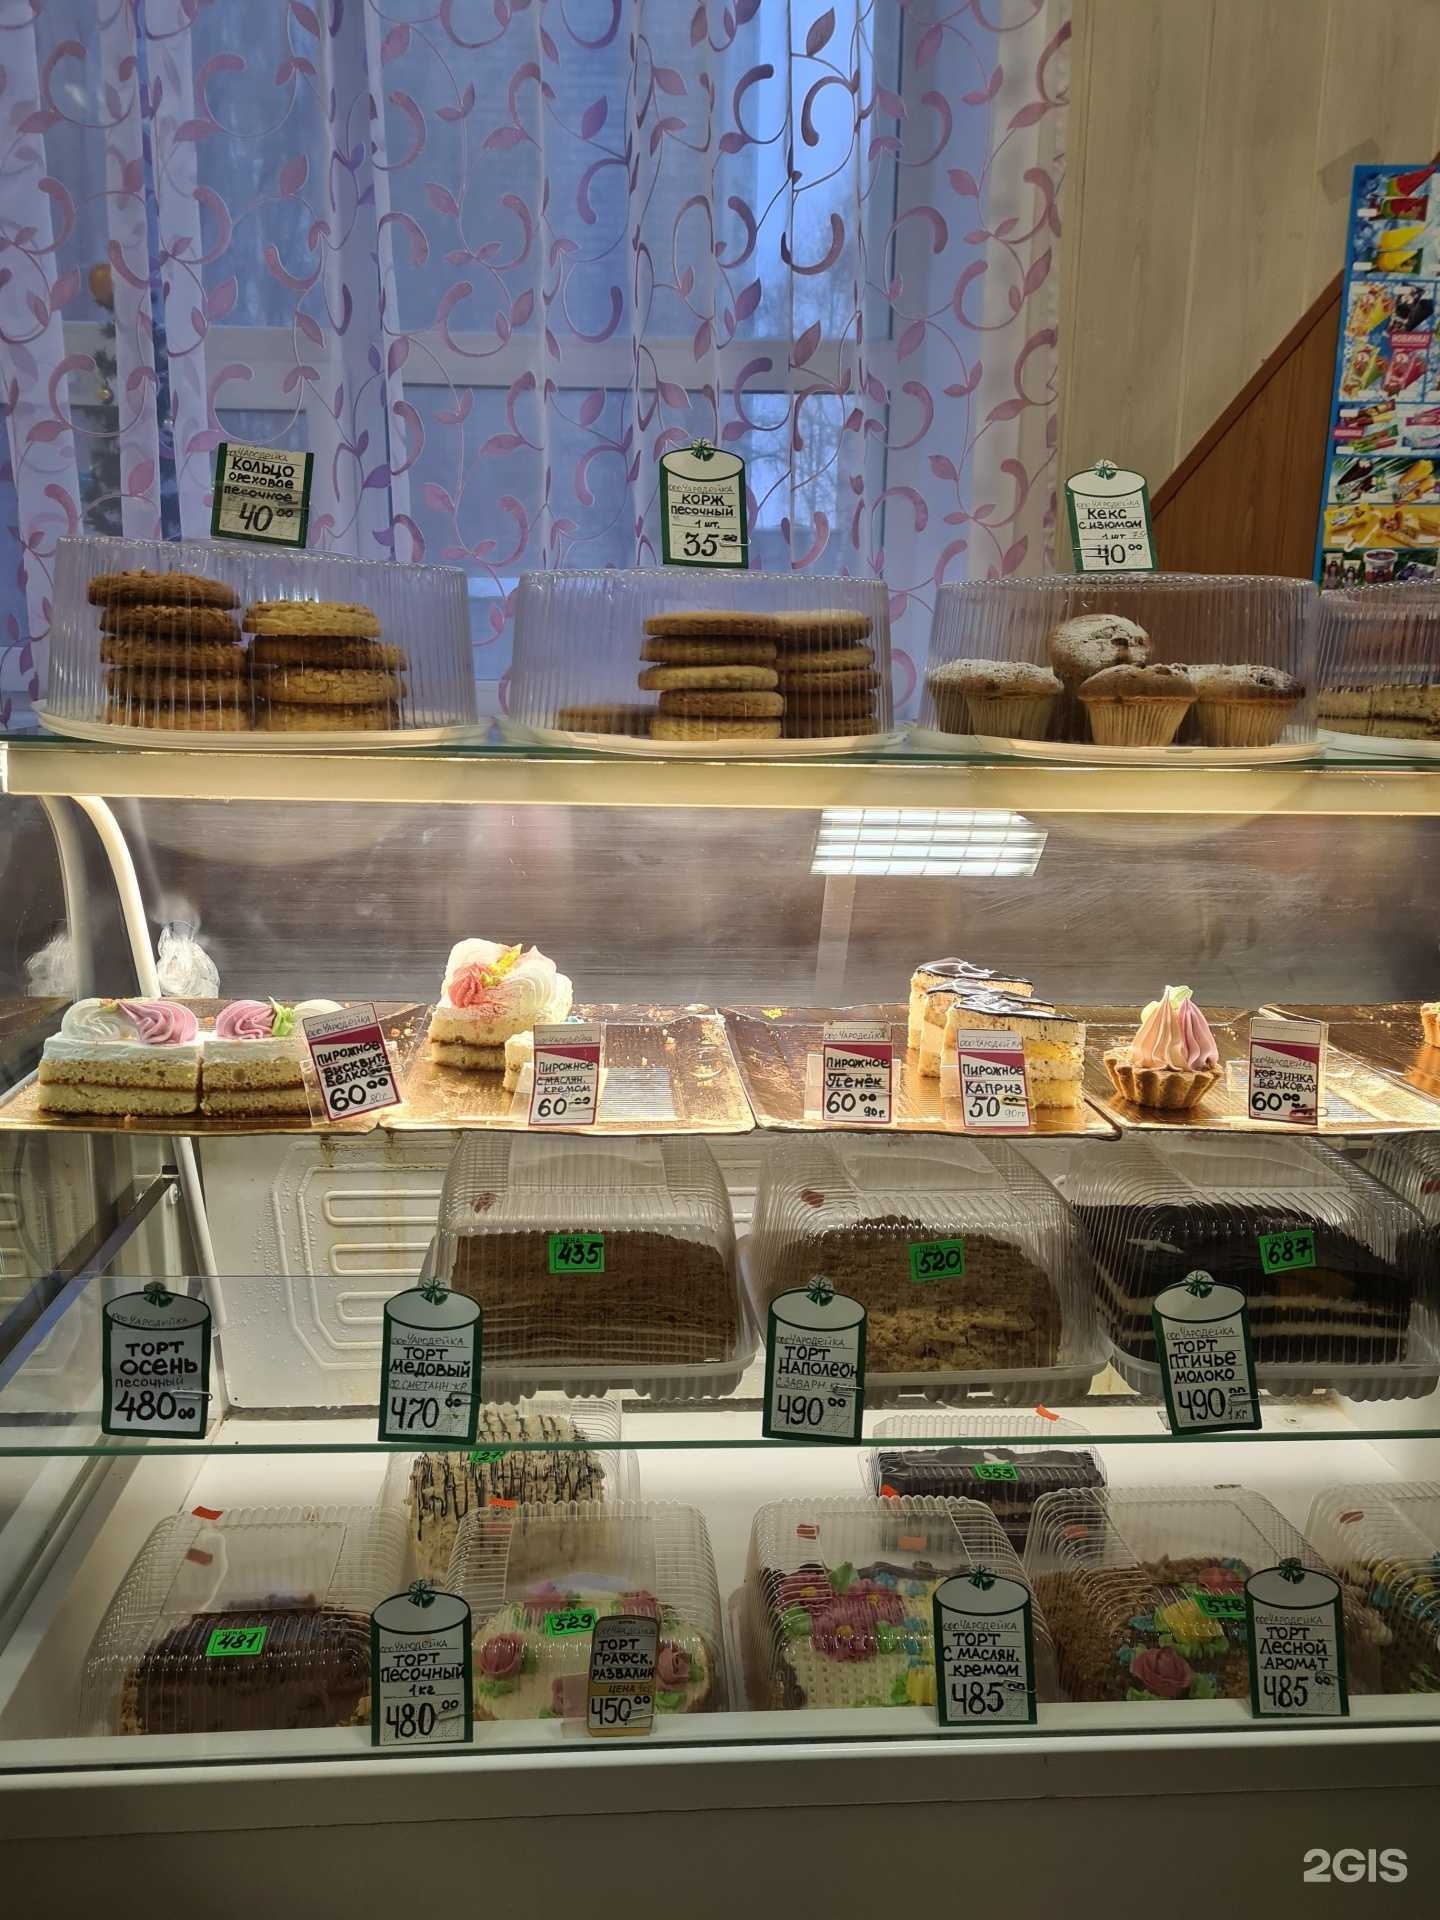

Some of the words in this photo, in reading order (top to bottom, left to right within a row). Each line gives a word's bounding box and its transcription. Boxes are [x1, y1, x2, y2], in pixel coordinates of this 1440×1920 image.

[232, 457, 295, 479] КОЛЬЦО
[682, 494, 724, 506] КОРЖ
[694, 520, 701, 528] 1
[965, 1081, 1023, 1096] КАПРИЗ
[558, 1242, 604, 1265] 435
[1268, 1237, 1313, 1265] 687
[918, 1248, 961, 1274] 520
[125, 1341, 185, 1357] ТОРТ
[403, 1346, 449, 1361] ТОРТ
[784, 1345, 831, 1361] ТОРТ
[1173, 1339, 1218, 1354] ТОРТ
[1174, 1368, 1235, 1384] МОЛОКО
[552, 1613, 593, 1632] 529
[217, 1632, 259, 1650] 481
[953, 1632, 1000, 1647] ТОРТ
[1266, 1626, 1310, 1641] ТОРТ
[598, 1638, 640, 1651] ТОРТ
[393, 1652, 440, 1667] ТОРТ
[1264, 1657, 1329, 1671] АРОМАТ
